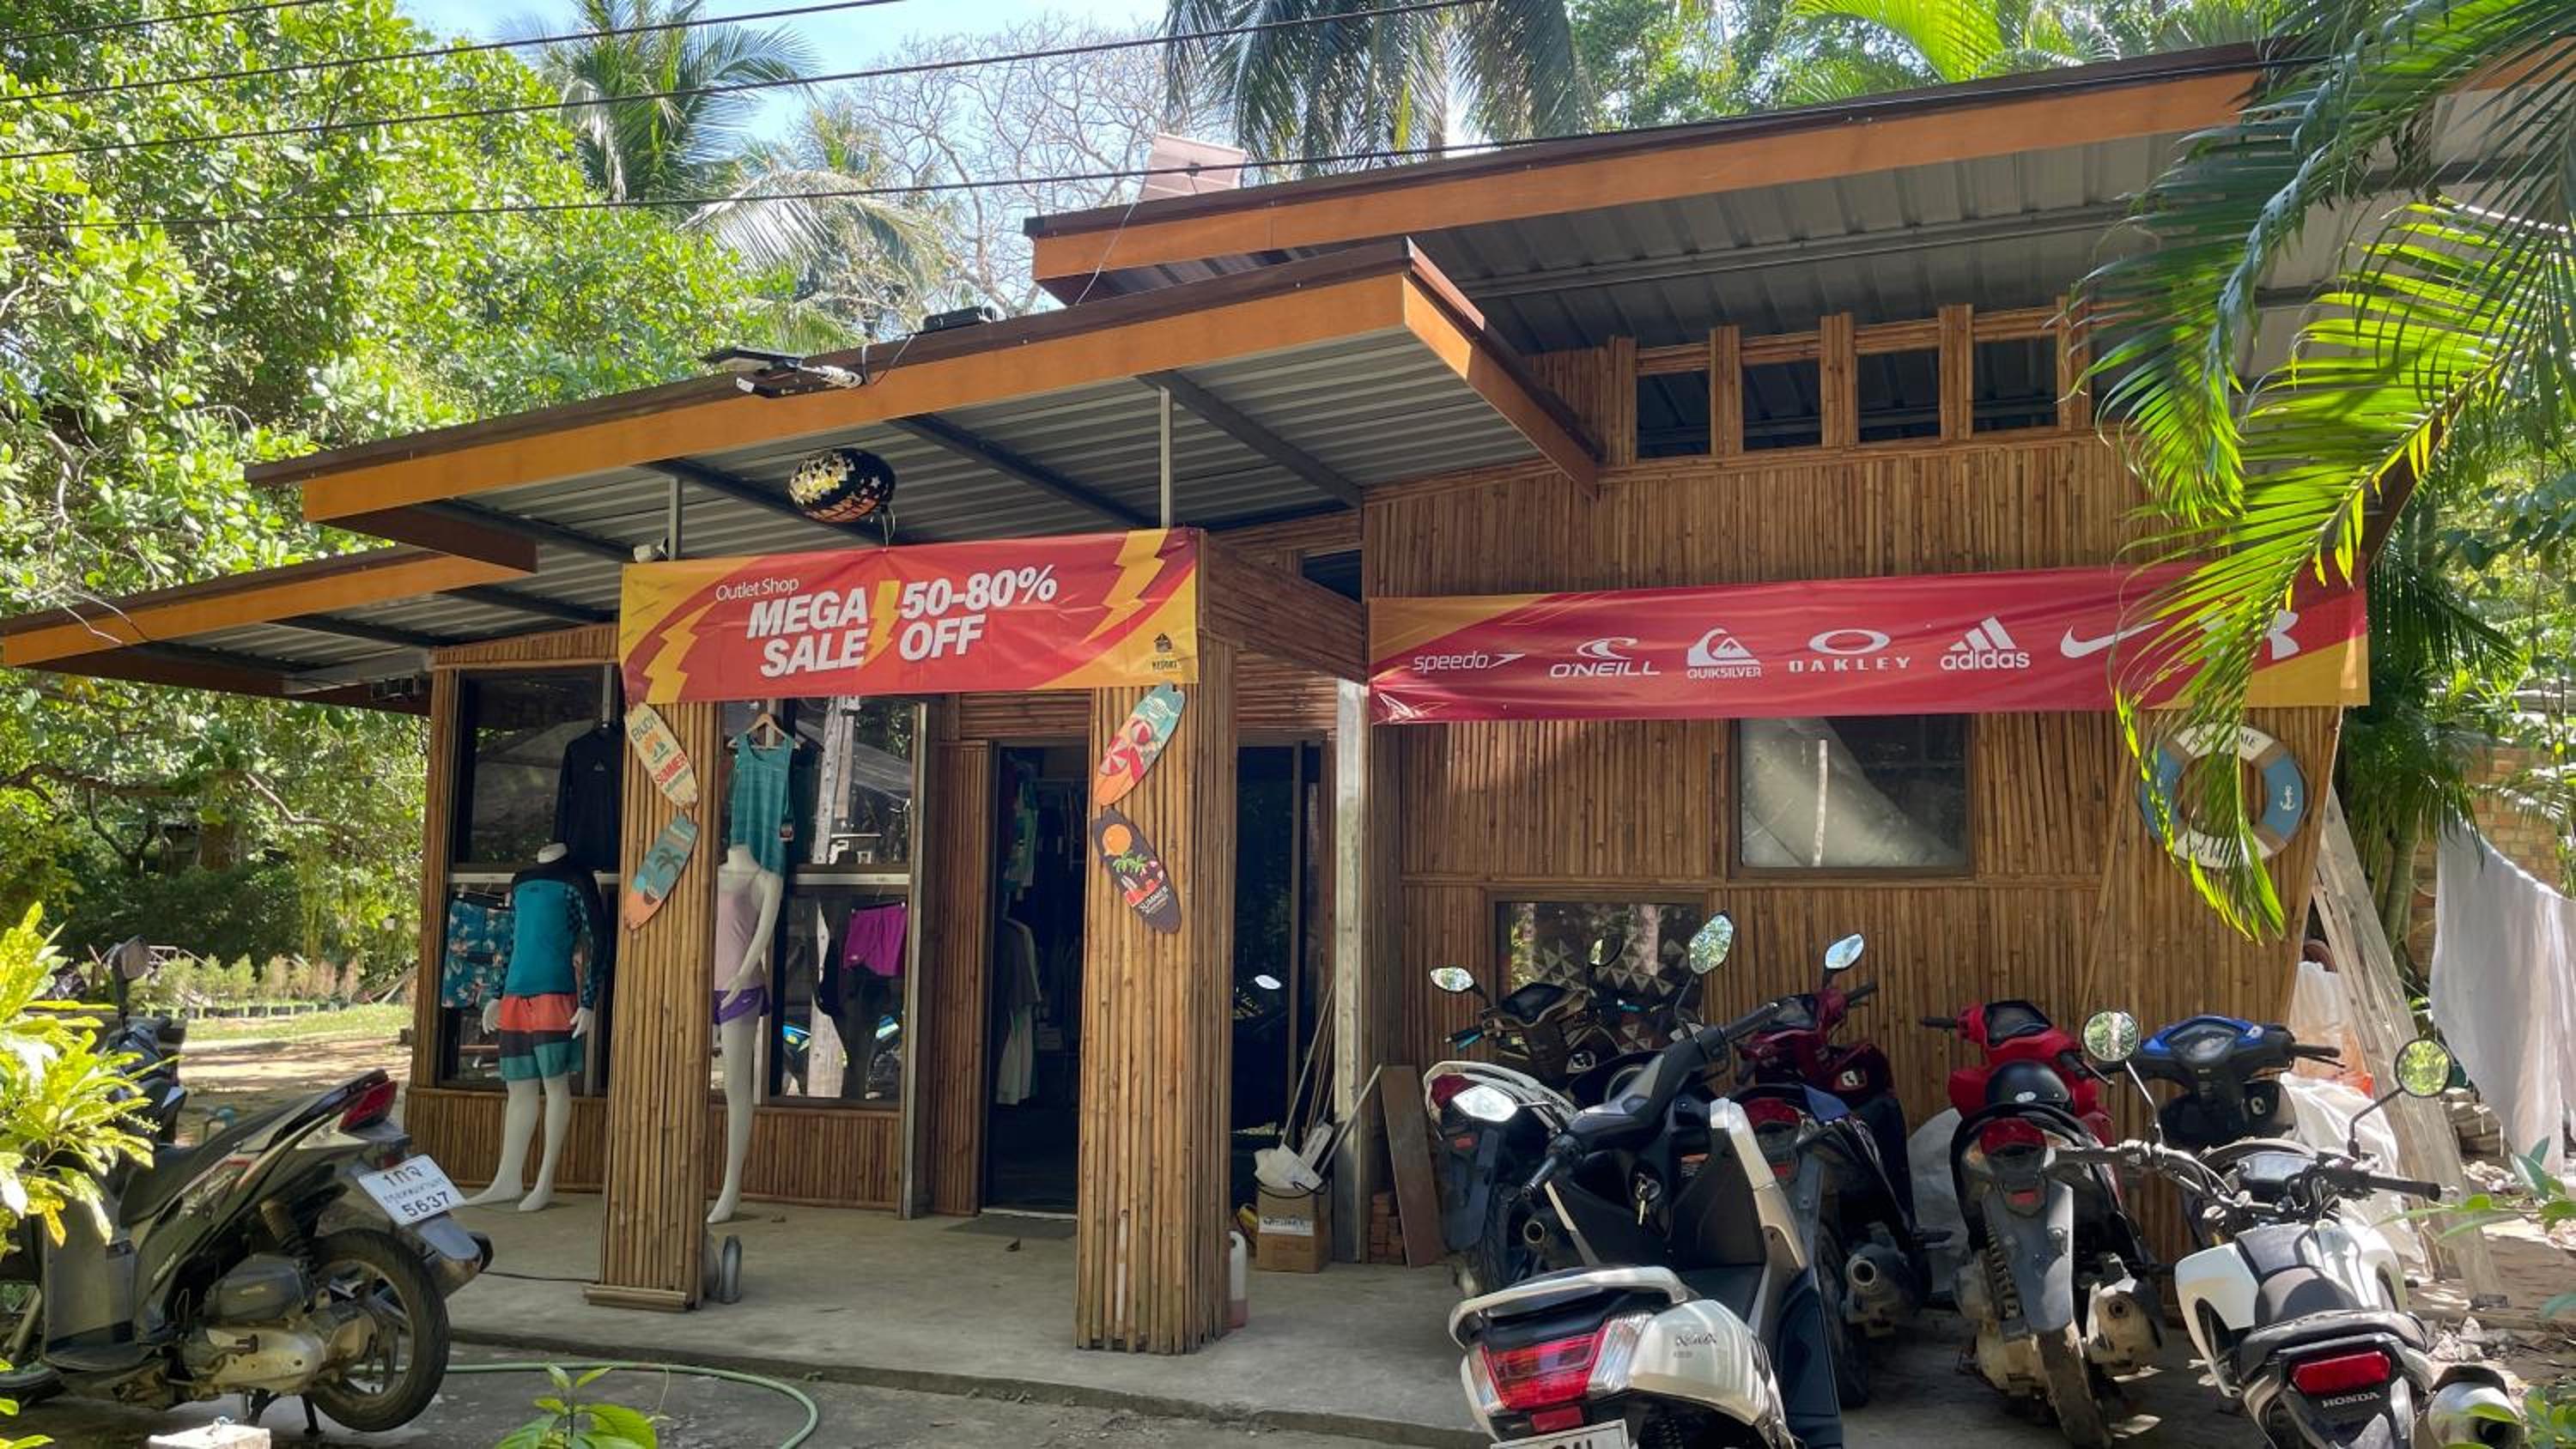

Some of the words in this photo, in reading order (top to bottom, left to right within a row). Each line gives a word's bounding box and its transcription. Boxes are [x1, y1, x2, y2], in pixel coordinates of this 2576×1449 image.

[715, 581, 761, 601] Outlet
[761, 577, 799, 595] Shop
[901, 564, 1057, 619] 50-80%
[746, 587, 868, 639] MEGA
[900, 614, 986, 660] OFF
[760, 627, 869, 678] SALE
[1412, 650, 1489, 672] speedo
[1788, 657, 1911, 672] OAKLEY
[1939, 647, 2032, 671] adidas
[1550, 661, 1662, 678] O'NEILL
[1686, 667, 1762, 681] QUIKSILVER
[401, 1191, 450, 1217] 5637
[2322, 1391, 2381, 1408] HONDA
